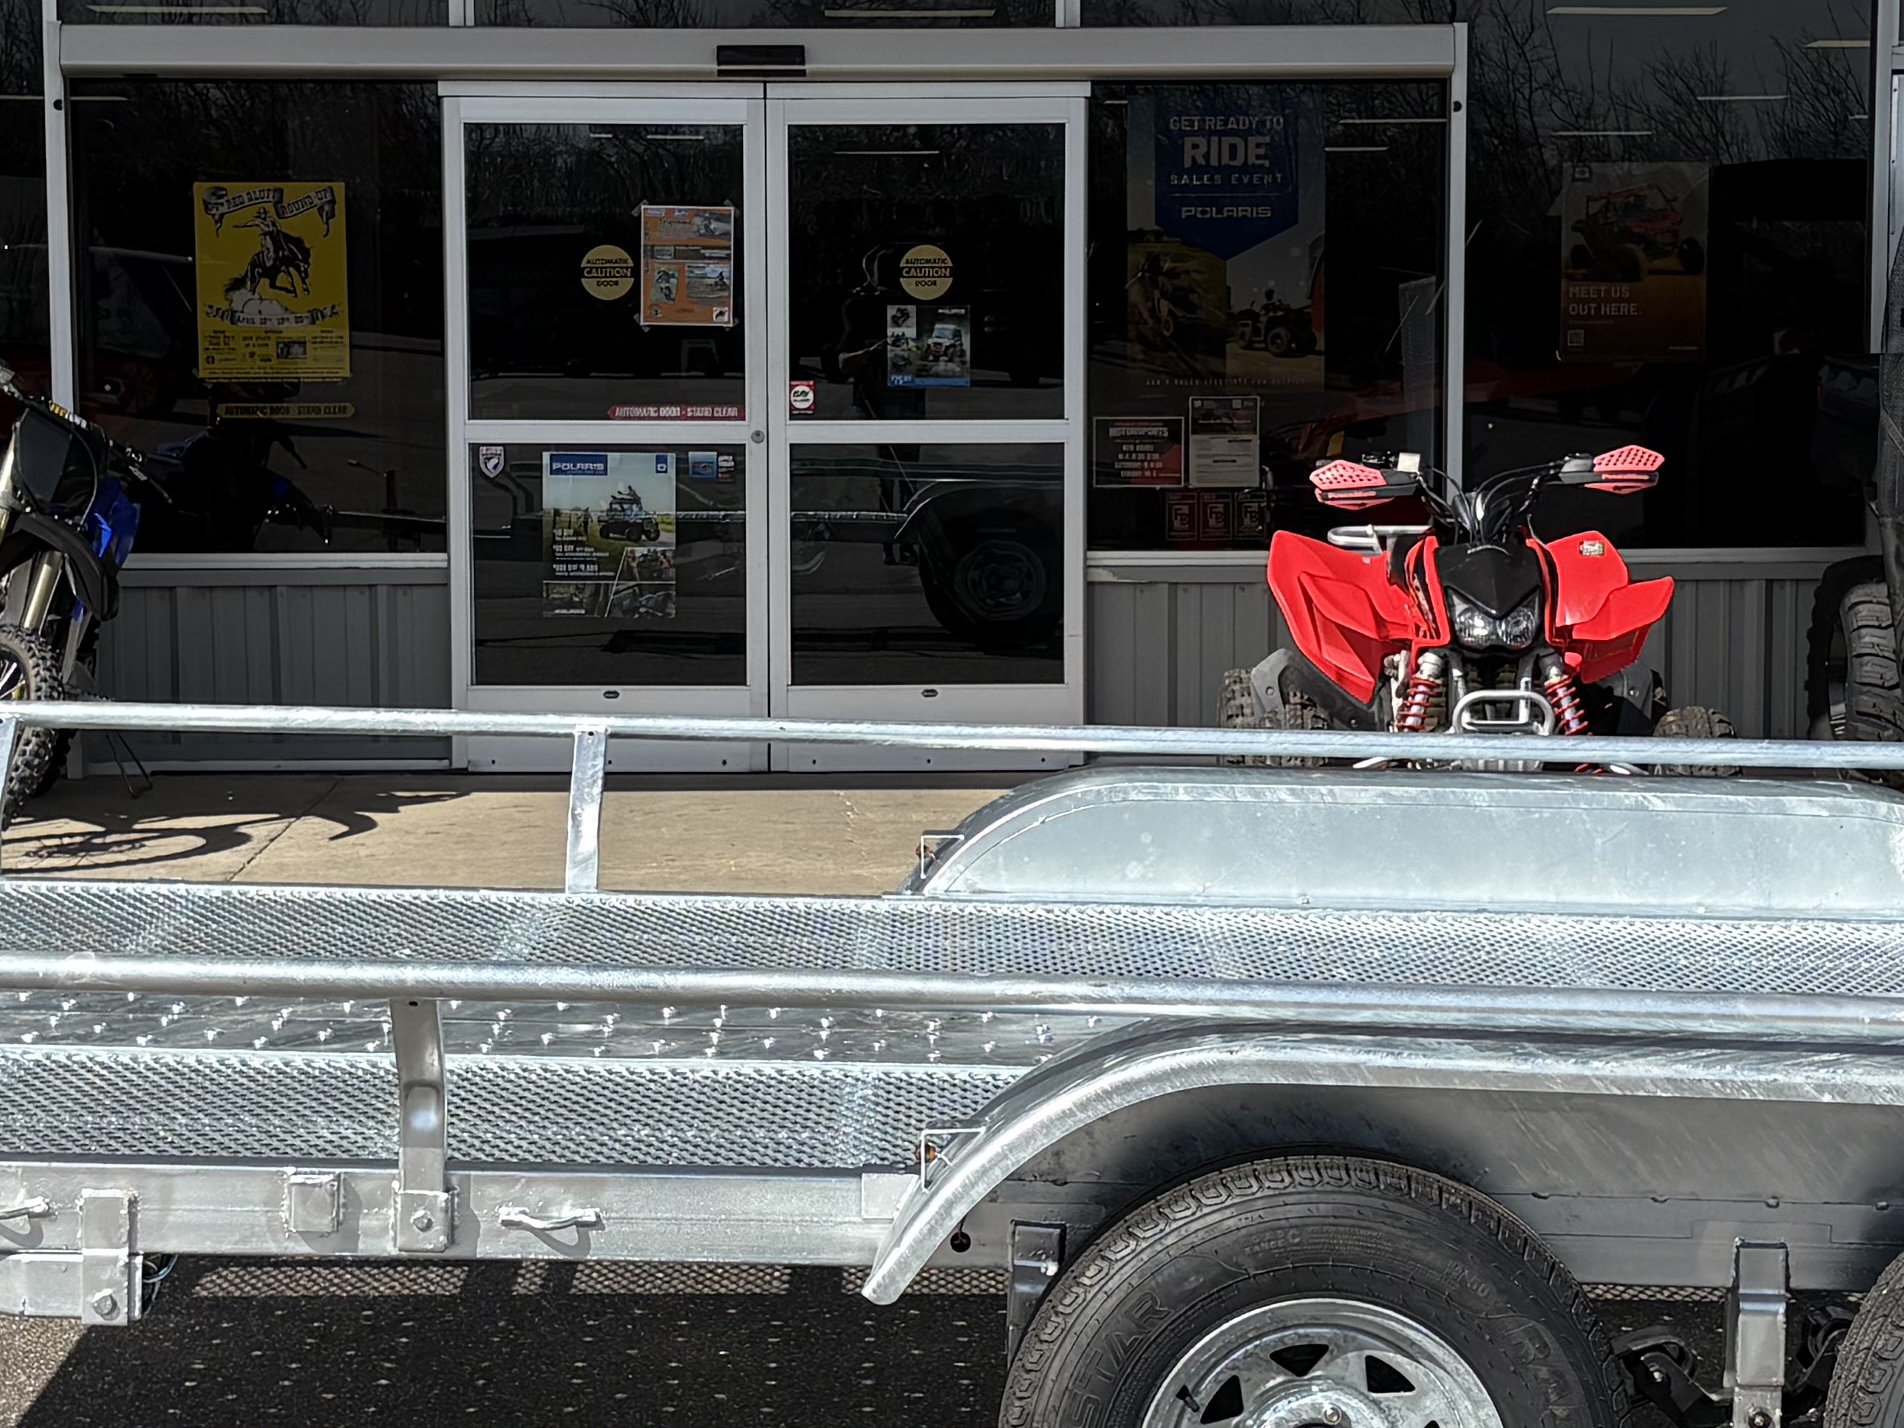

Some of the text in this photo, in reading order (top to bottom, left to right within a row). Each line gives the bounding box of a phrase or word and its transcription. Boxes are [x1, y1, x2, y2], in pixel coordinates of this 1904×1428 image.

[1170, 116, 1284, 131] GET READY TO
[1184, 136, 1272, 169] RIDE
[1170, 172, 1283, 186] SALES EVENT
[1181, 206, 1272, 221] POLARIS
[583, 267, 632, 278] CAUTION
[902, 267, 951, 277] CAUTION
[1568, 285, 1630, 298] MEET US
[1568, 303, 1643, 316] OUT HERE.
[552, 461, 605, 472] POLARIS
